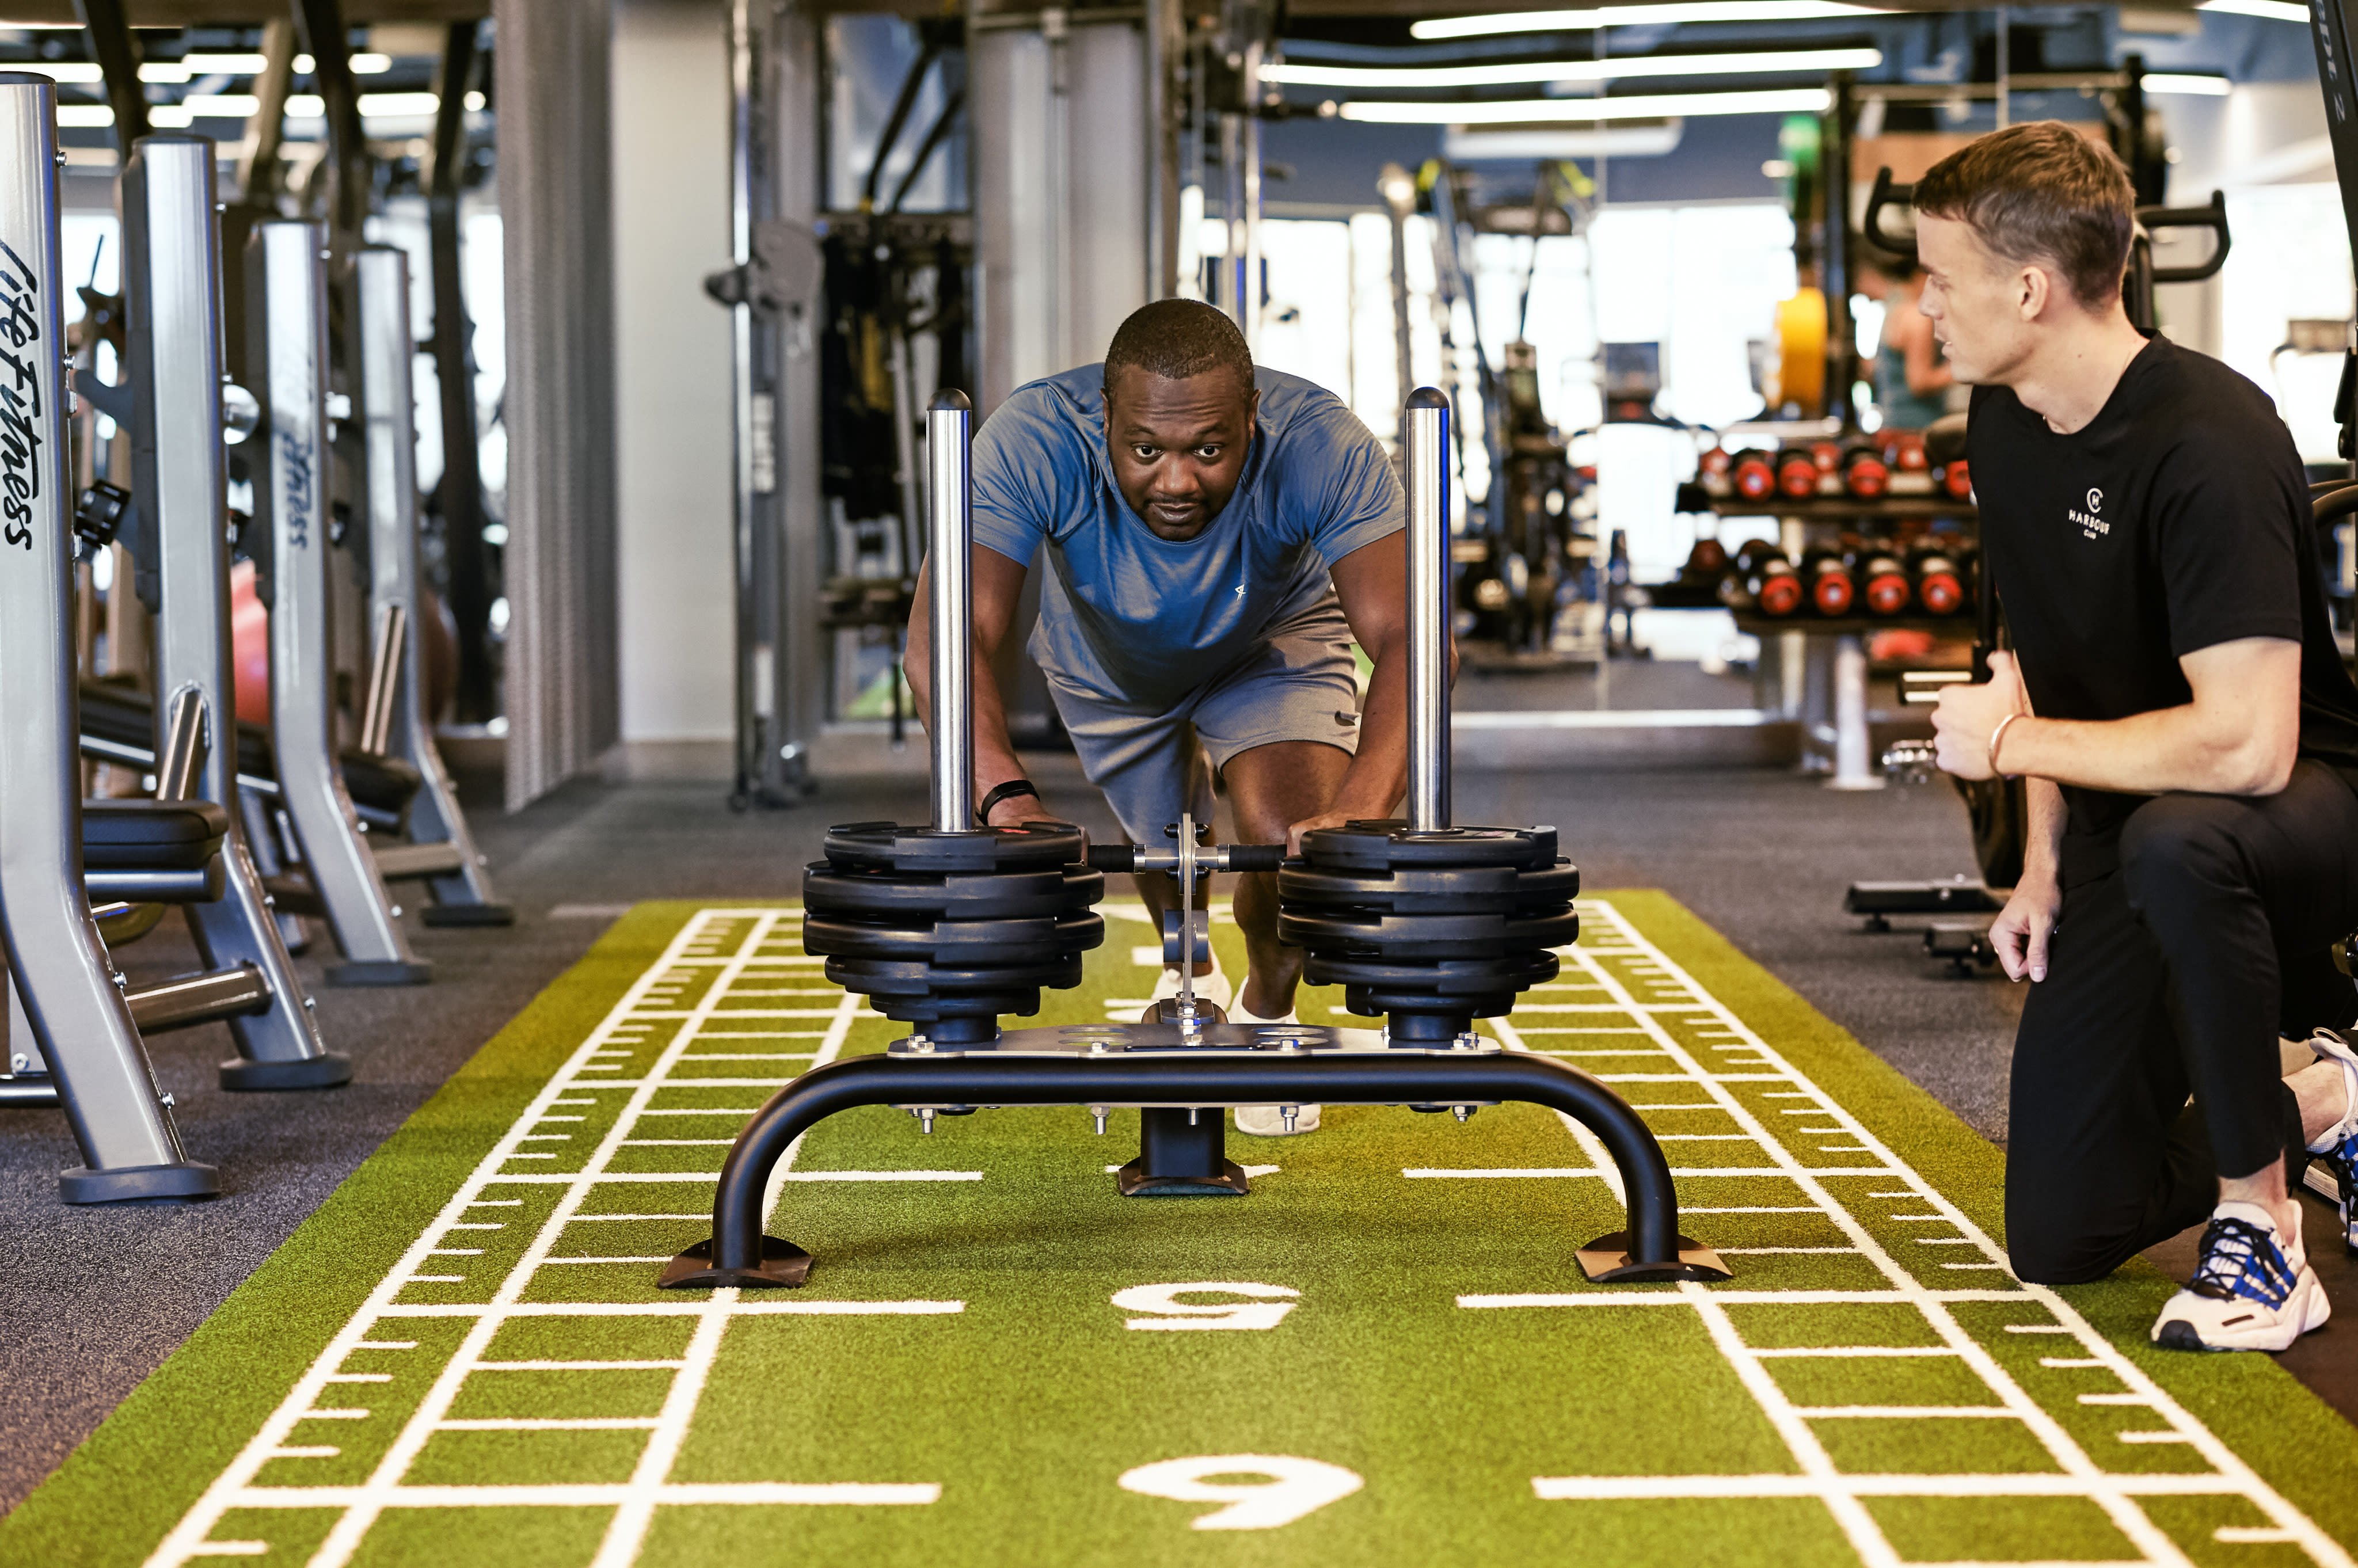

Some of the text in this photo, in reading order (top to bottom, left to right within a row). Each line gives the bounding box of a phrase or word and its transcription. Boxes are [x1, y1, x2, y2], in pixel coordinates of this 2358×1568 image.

[2334, 93, 2346, 123] 2
[0, 347, 43, 551] Fitness
[2068, 509, 2110, 535] HARBOUR
[1111, 1281, 1301, 1331] 5
